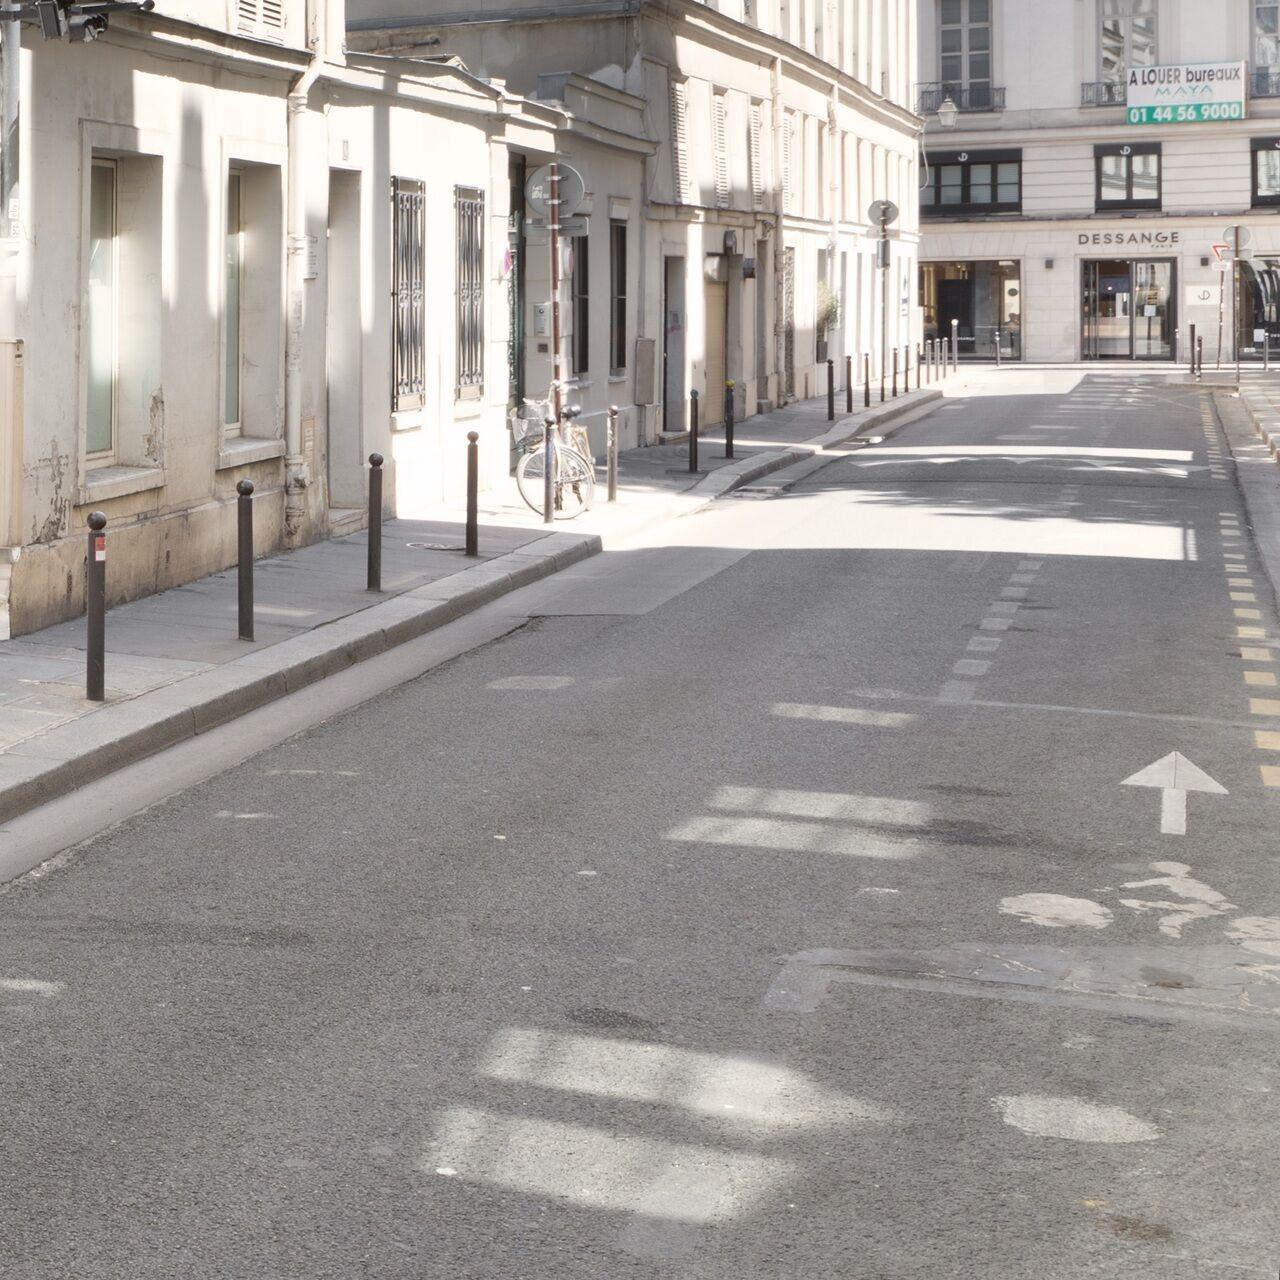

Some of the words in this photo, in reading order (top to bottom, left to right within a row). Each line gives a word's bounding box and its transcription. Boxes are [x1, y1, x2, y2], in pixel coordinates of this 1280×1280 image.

[1129, 71, 1138, 86] A
[1142, 68, 1181, 85] LOUER
[1186, 67, 1240, 82] bureaux
[1155, 84, 1213, 97] MAYA
[1130, 109, 1146, 123] 01
[1153, 107, 1172, 121] 44
[1177, 105, 1196, 120] 56
[1201, 103, 1239, 119] 9000
[1078, 232, 1179, 244] DESSANGE
